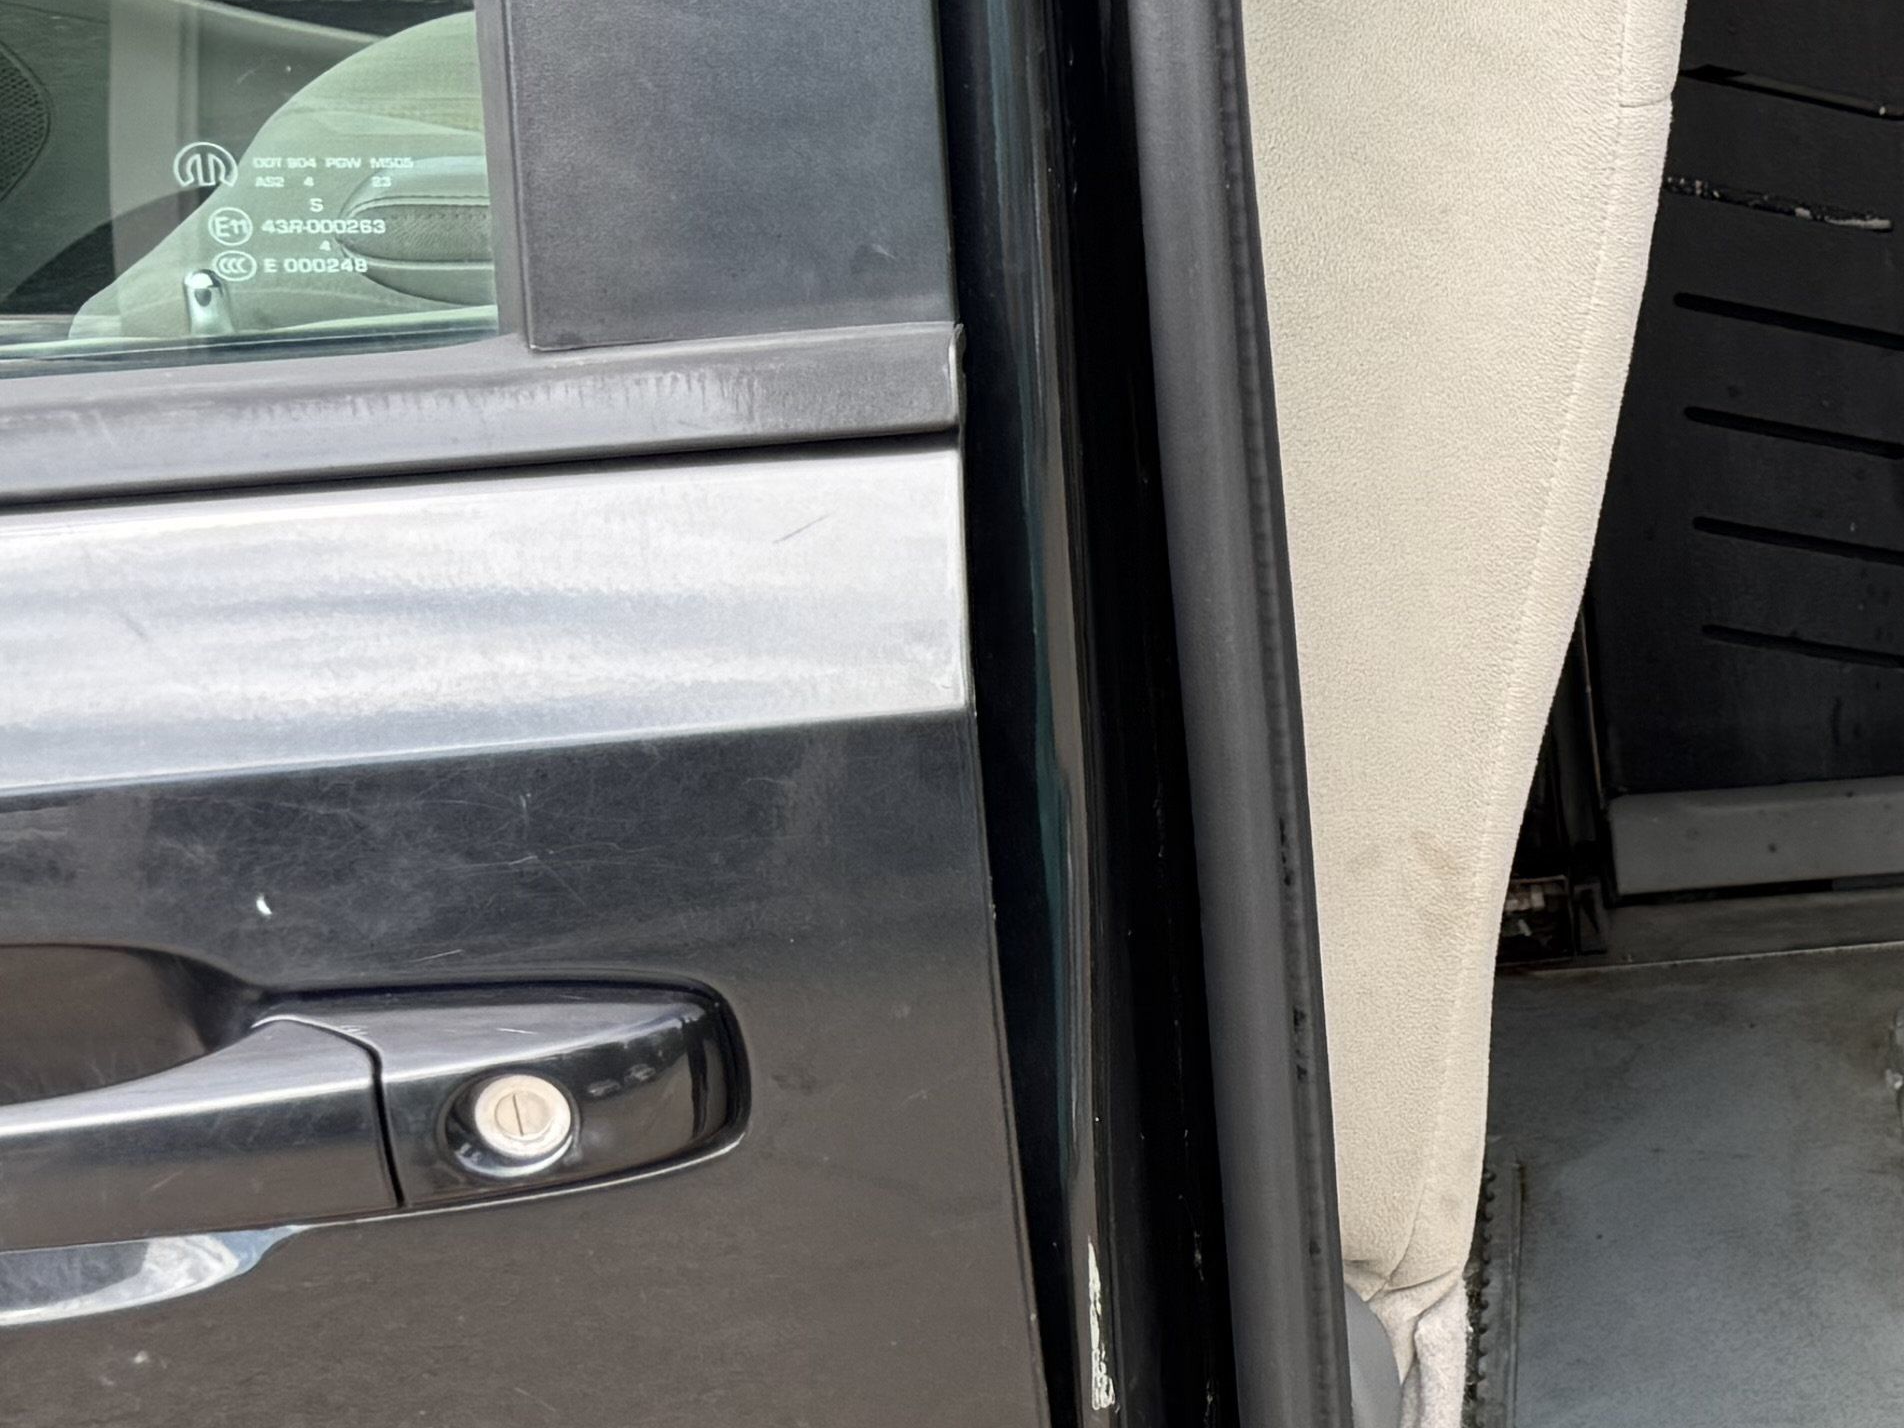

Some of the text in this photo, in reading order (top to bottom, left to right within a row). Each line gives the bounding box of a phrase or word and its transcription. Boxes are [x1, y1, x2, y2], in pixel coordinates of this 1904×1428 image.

[253, 157, 282, 169] DOT
[325, 157, 362, 169] PGW
[255, 176, 285, 188] AS2
[309, 198, 324, 213] S
[263, 258, 278, 273] E
